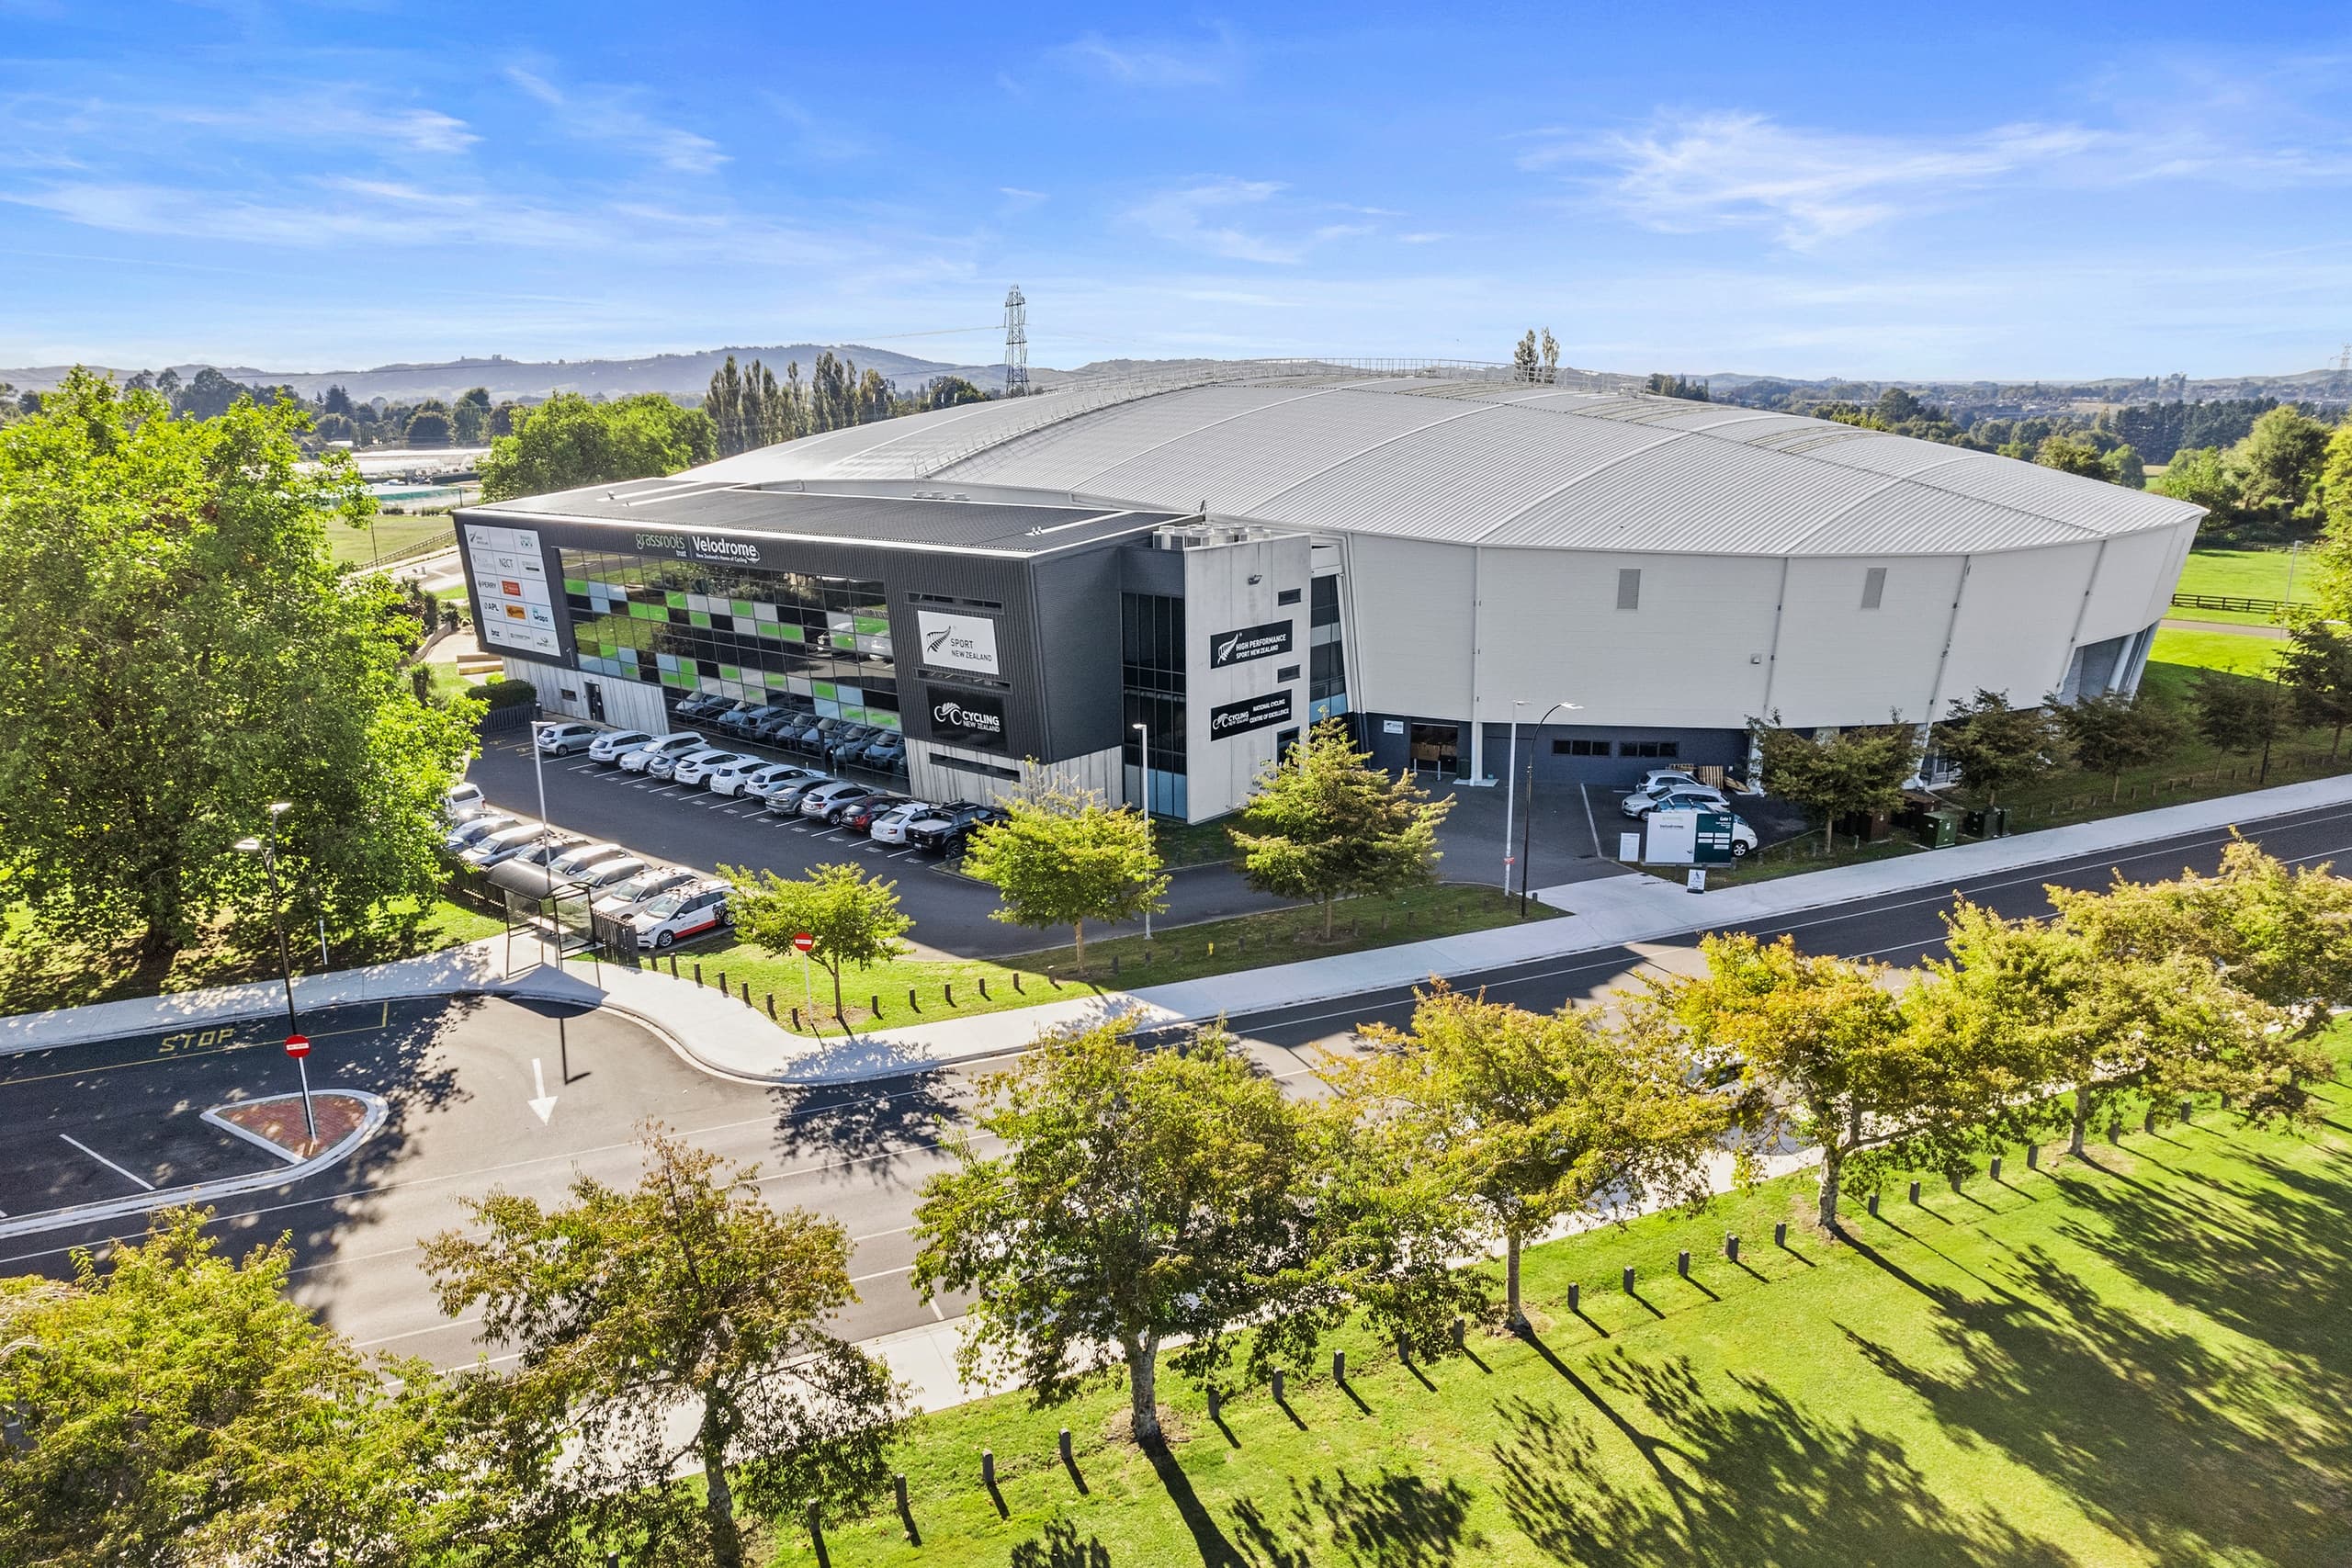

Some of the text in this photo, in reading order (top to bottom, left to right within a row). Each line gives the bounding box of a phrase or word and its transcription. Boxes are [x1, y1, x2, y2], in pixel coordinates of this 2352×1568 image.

[635, 533, 685, 550] grassroots
[692, 536, 757, 557] Velodrome
[950, 638, 974, 649] SPORT
[1236, 634, 1286, 651] HIGH PERFORMANCE
[966, 652, 993, 662] ZEALAND
[1236, 650, 1250, 659] SPORT
[1260, 644, 1279, 654] ZEALAND
[1253, 699, 1285, 711] NATIONAL CYCLING
[962, 710, 1000, 726] CYCLING
[1228, 711, 1249, 721] CYCLING
[1249, 714, 1263, 724] CENTRE
[1268, 708, 1289, 719] EXCELLENCE
[977, 723, 1000, 733] ZEALAND
[158, 1028, 235, 1053] STOP
